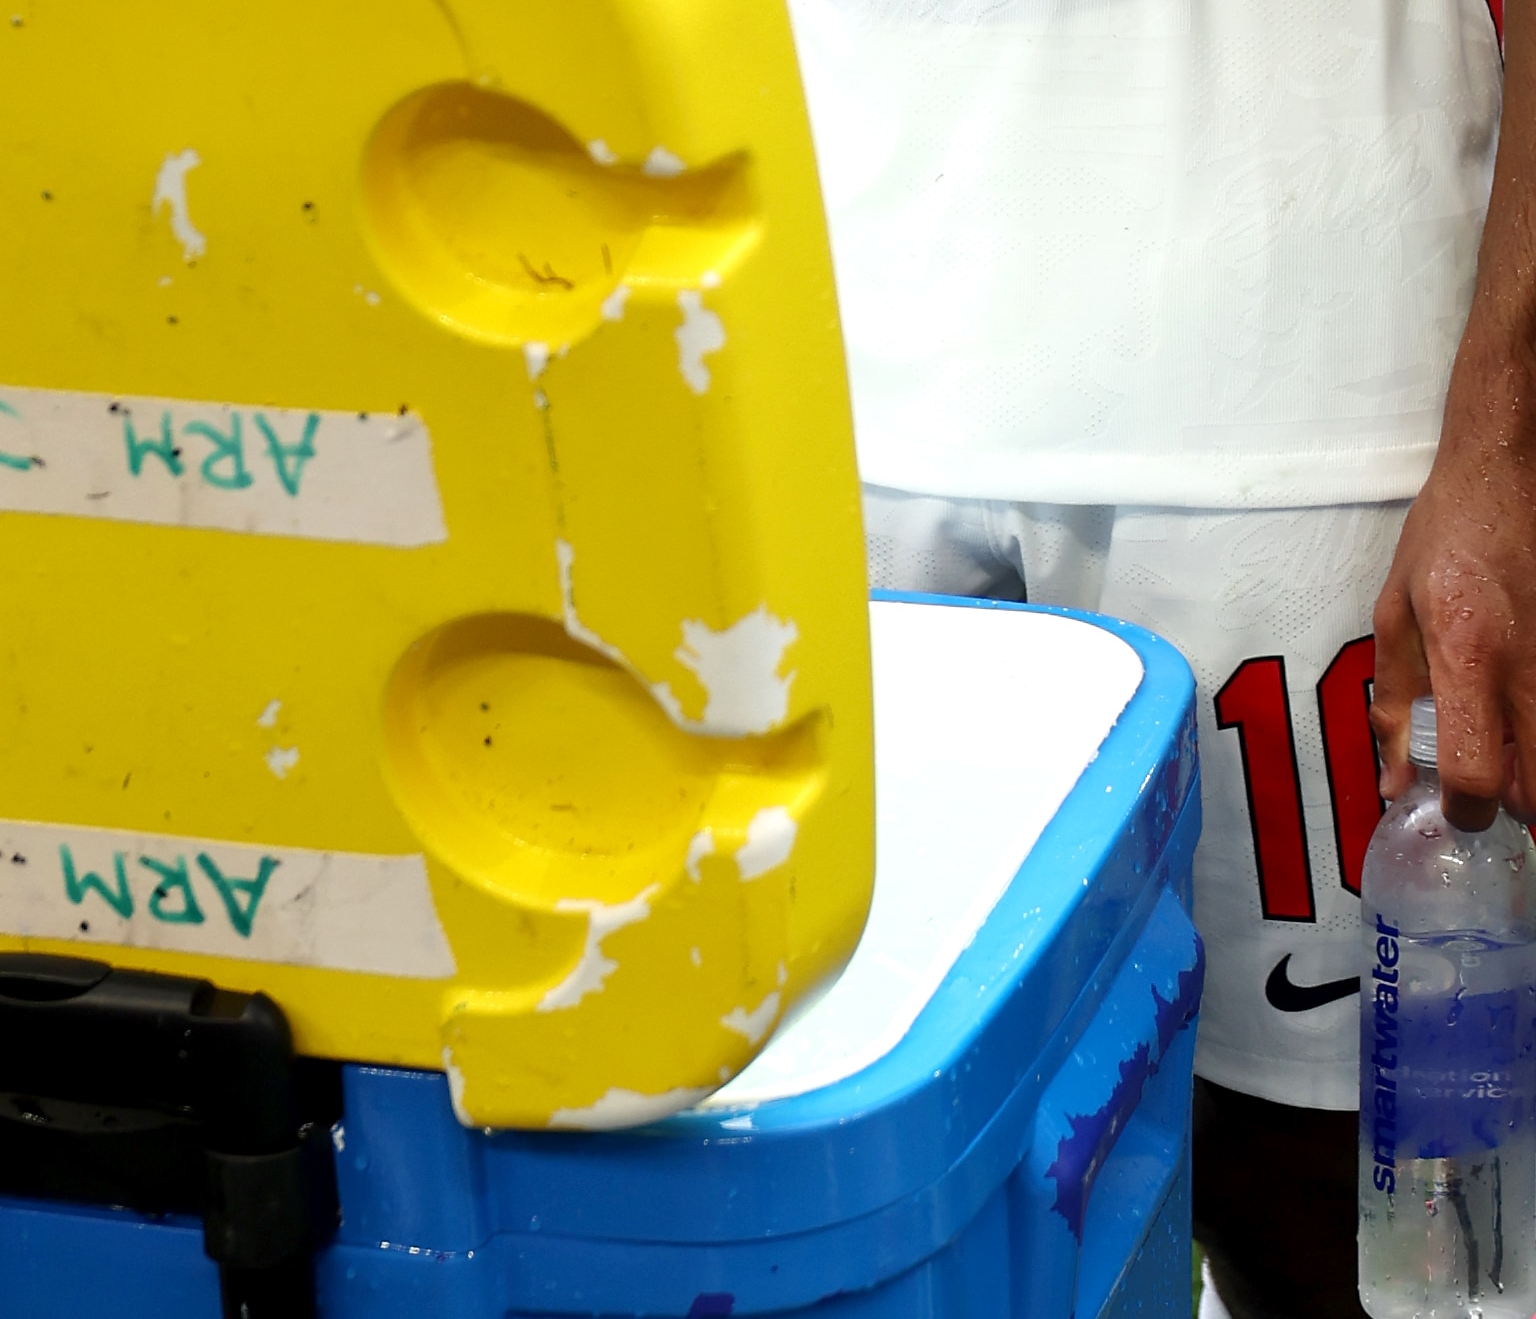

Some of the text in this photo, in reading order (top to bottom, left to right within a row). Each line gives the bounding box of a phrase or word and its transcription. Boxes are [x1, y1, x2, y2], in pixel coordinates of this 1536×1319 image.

[124, 410, 320, 497] ARM
[59, 843, 280, 939] ARM
[1371, 913, 1401, 1195] smartwater
